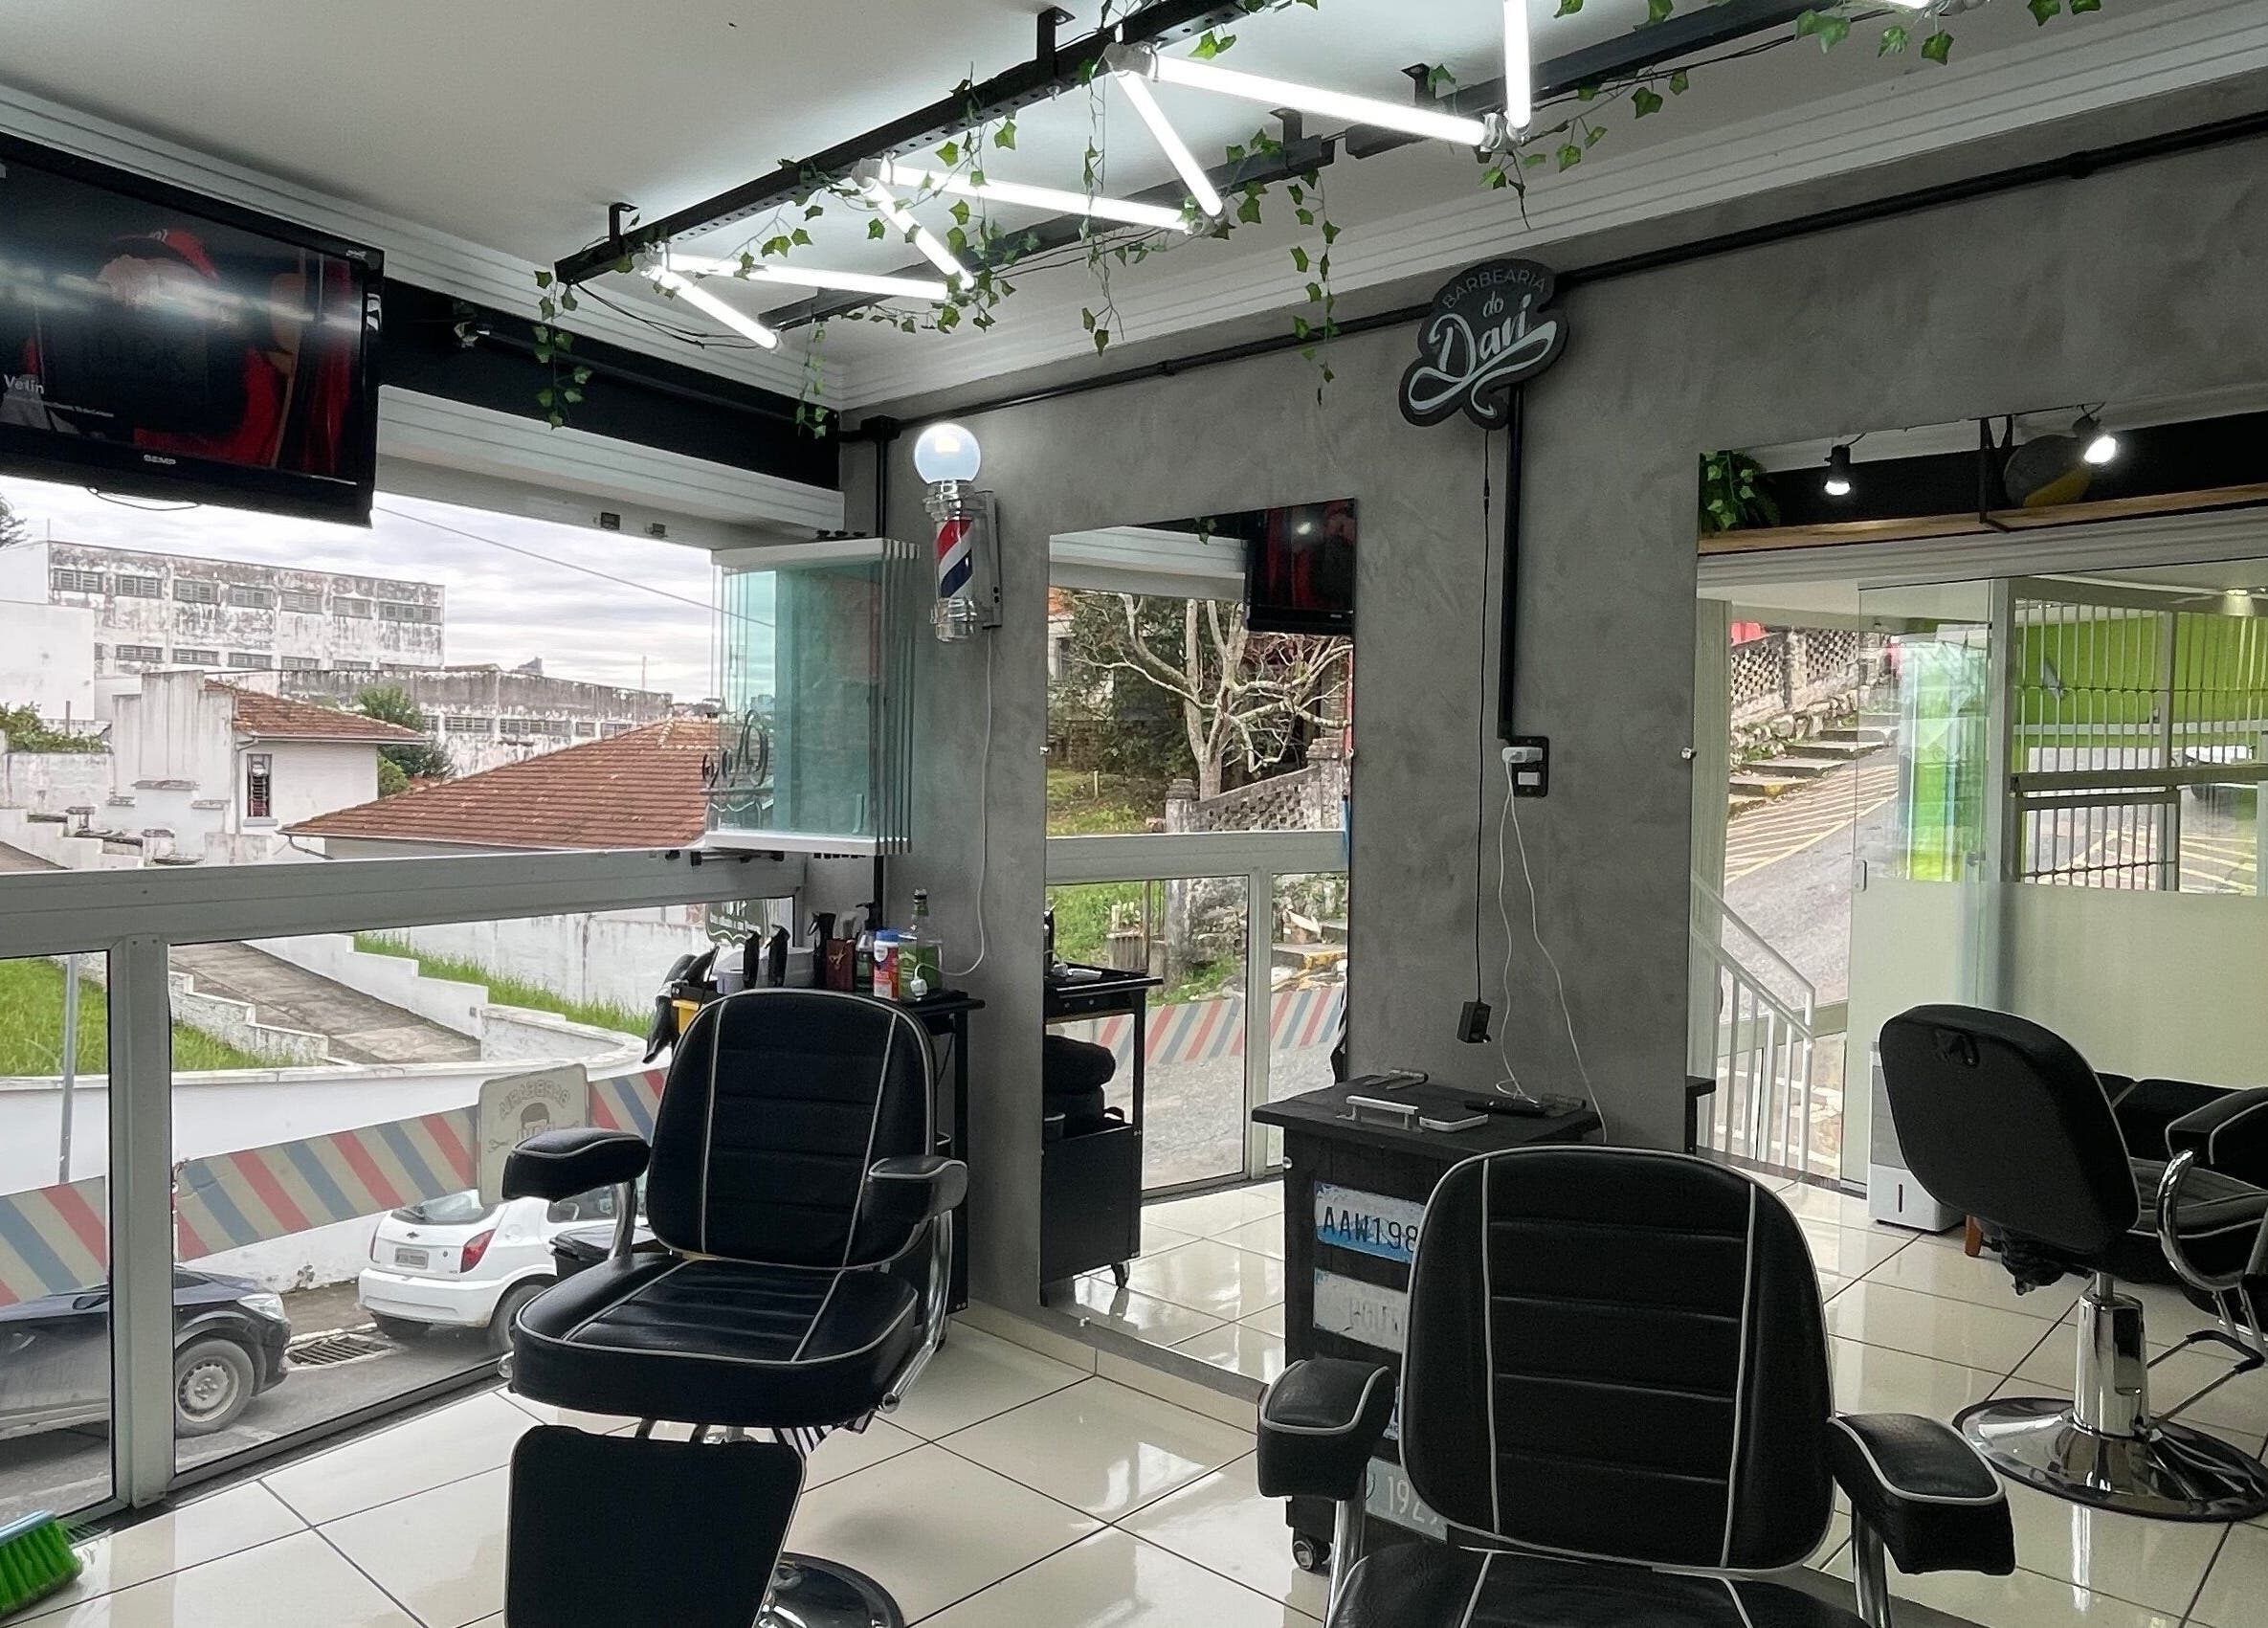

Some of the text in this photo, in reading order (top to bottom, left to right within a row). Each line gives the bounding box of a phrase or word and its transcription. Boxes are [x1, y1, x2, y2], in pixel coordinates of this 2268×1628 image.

[1441, 268, 1546, 308] BARBEARIA
[1481, 291, 1504, 318] do
[1409, 294, 1557, 404] Davi
